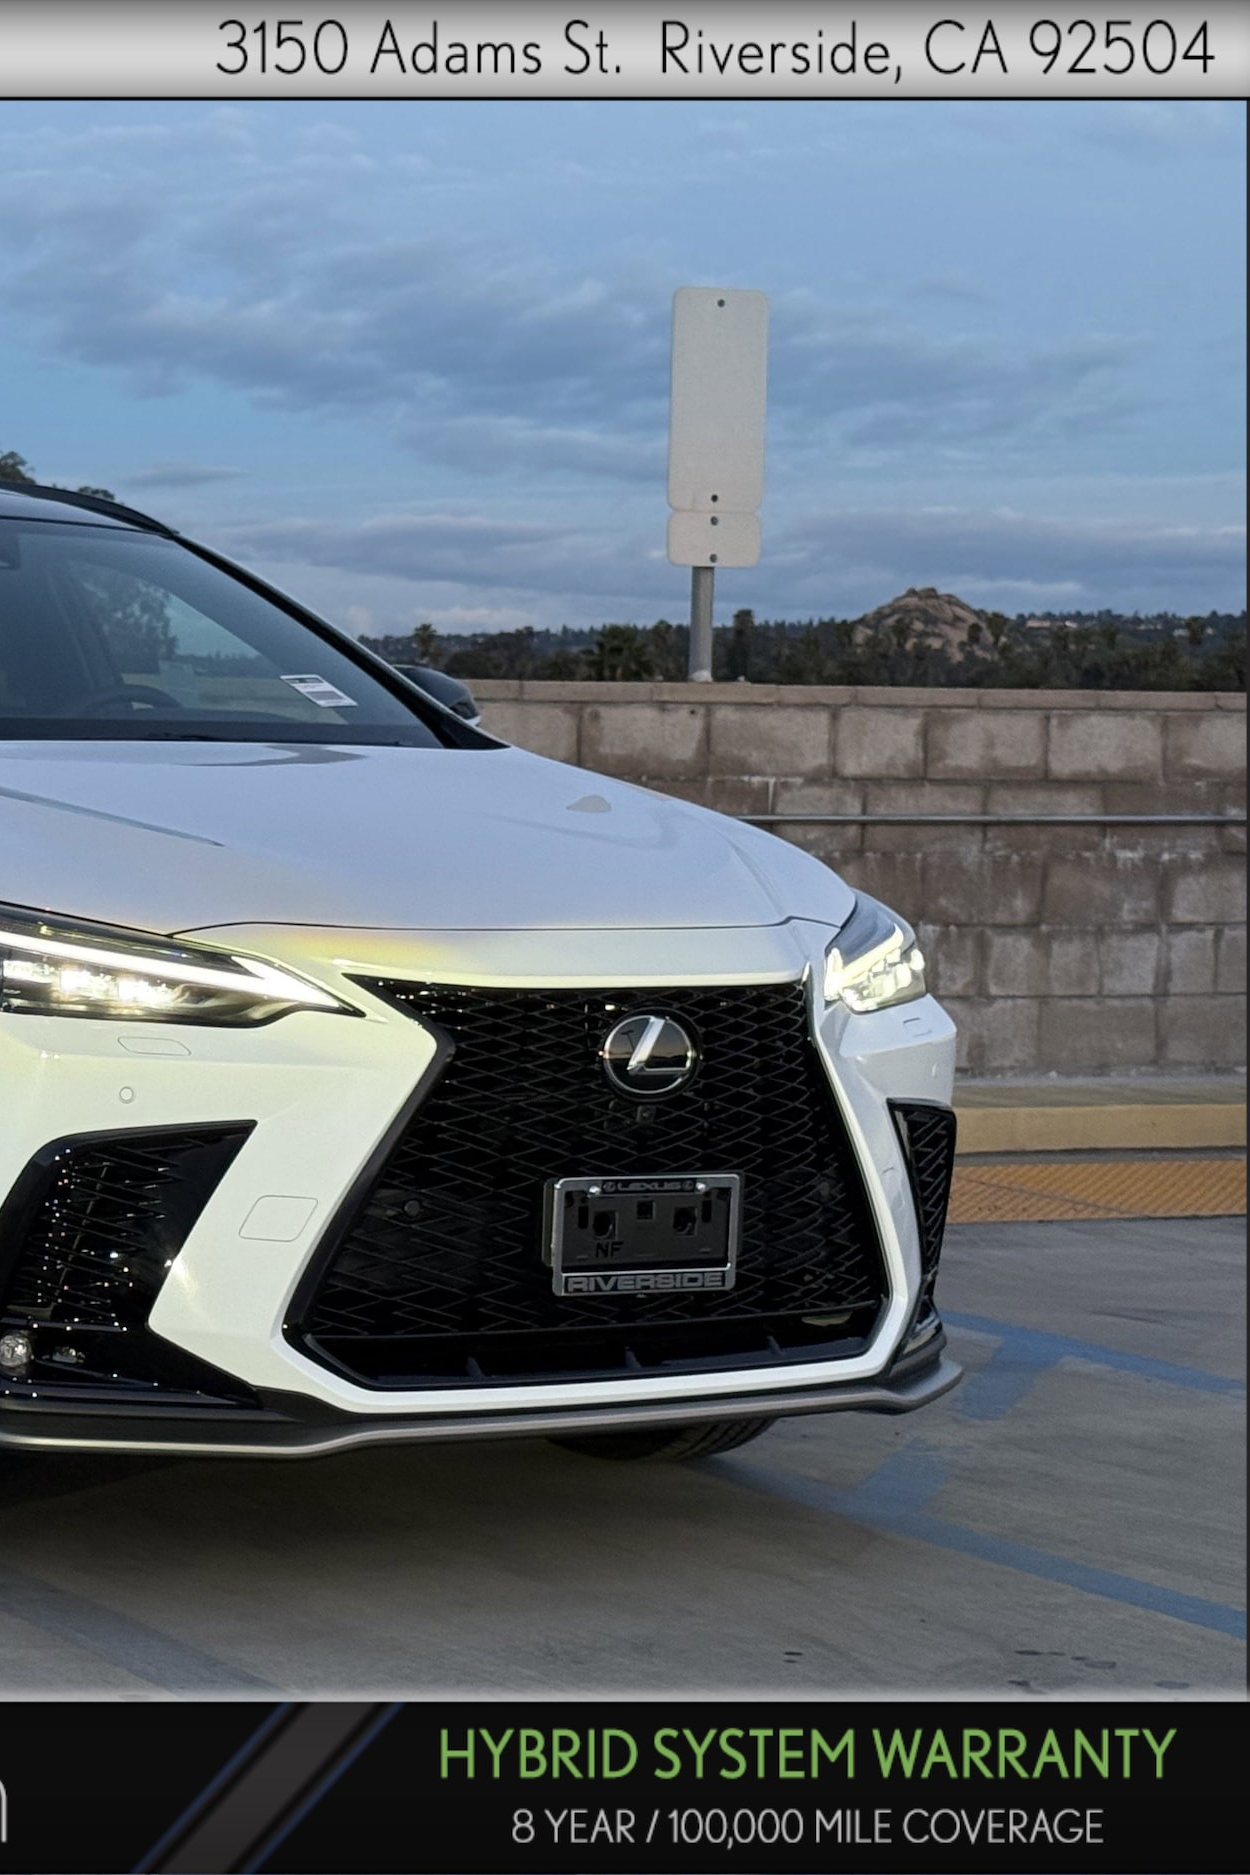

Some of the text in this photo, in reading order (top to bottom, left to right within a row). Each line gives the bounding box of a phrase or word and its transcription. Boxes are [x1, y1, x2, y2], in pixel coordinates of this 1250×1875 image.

[617, 1181, 682, 1192] LEXUS
[595, 1240, 624, 1259] NF
[567, 1272, 723, 1293] RIVERSIDE
